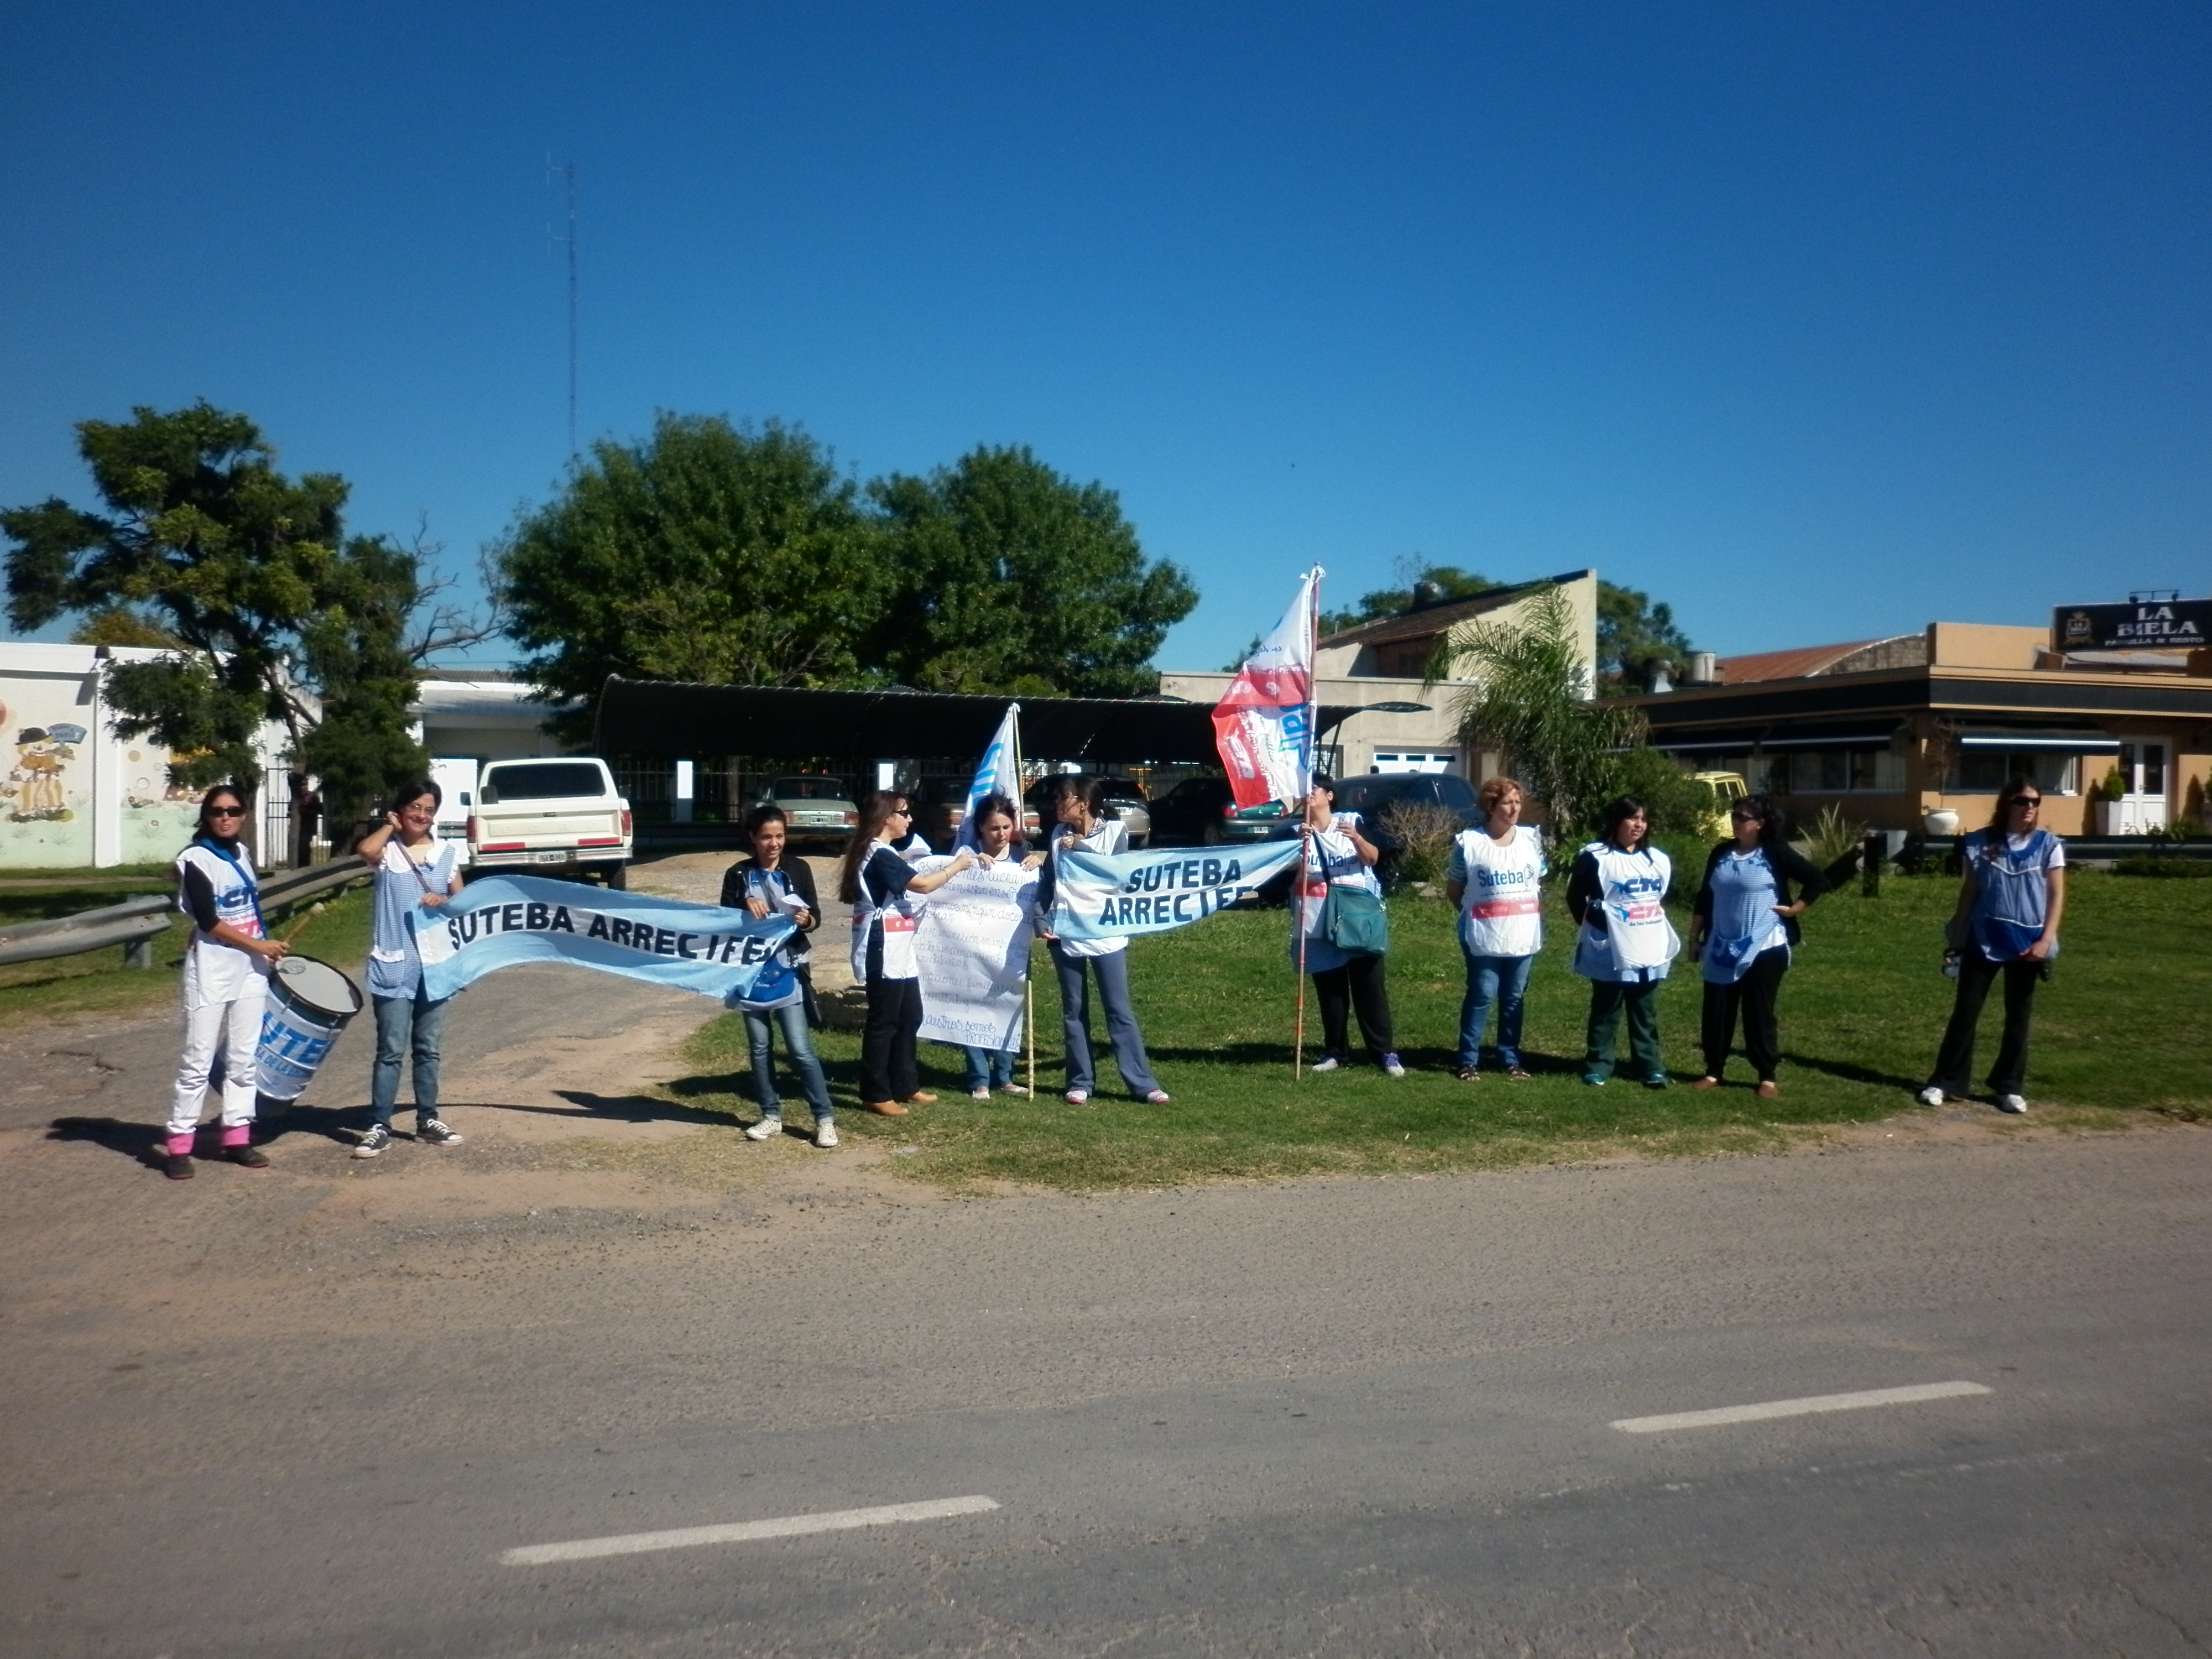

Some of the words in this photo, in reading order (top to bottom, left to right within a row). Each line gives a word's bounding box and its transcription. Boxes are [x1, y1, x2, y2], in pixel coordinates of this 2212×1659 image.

[2137, 606, 2174, 620] LA
[2117, 621, 2198, 636] BIELA
[1302, 848, 1344, 868] Suba
[1125, 859, 1241, 894] SUTEBA
[1477, 869, 1524, 888] Suteba
[448, 902, 575, 951] SUTEBA
